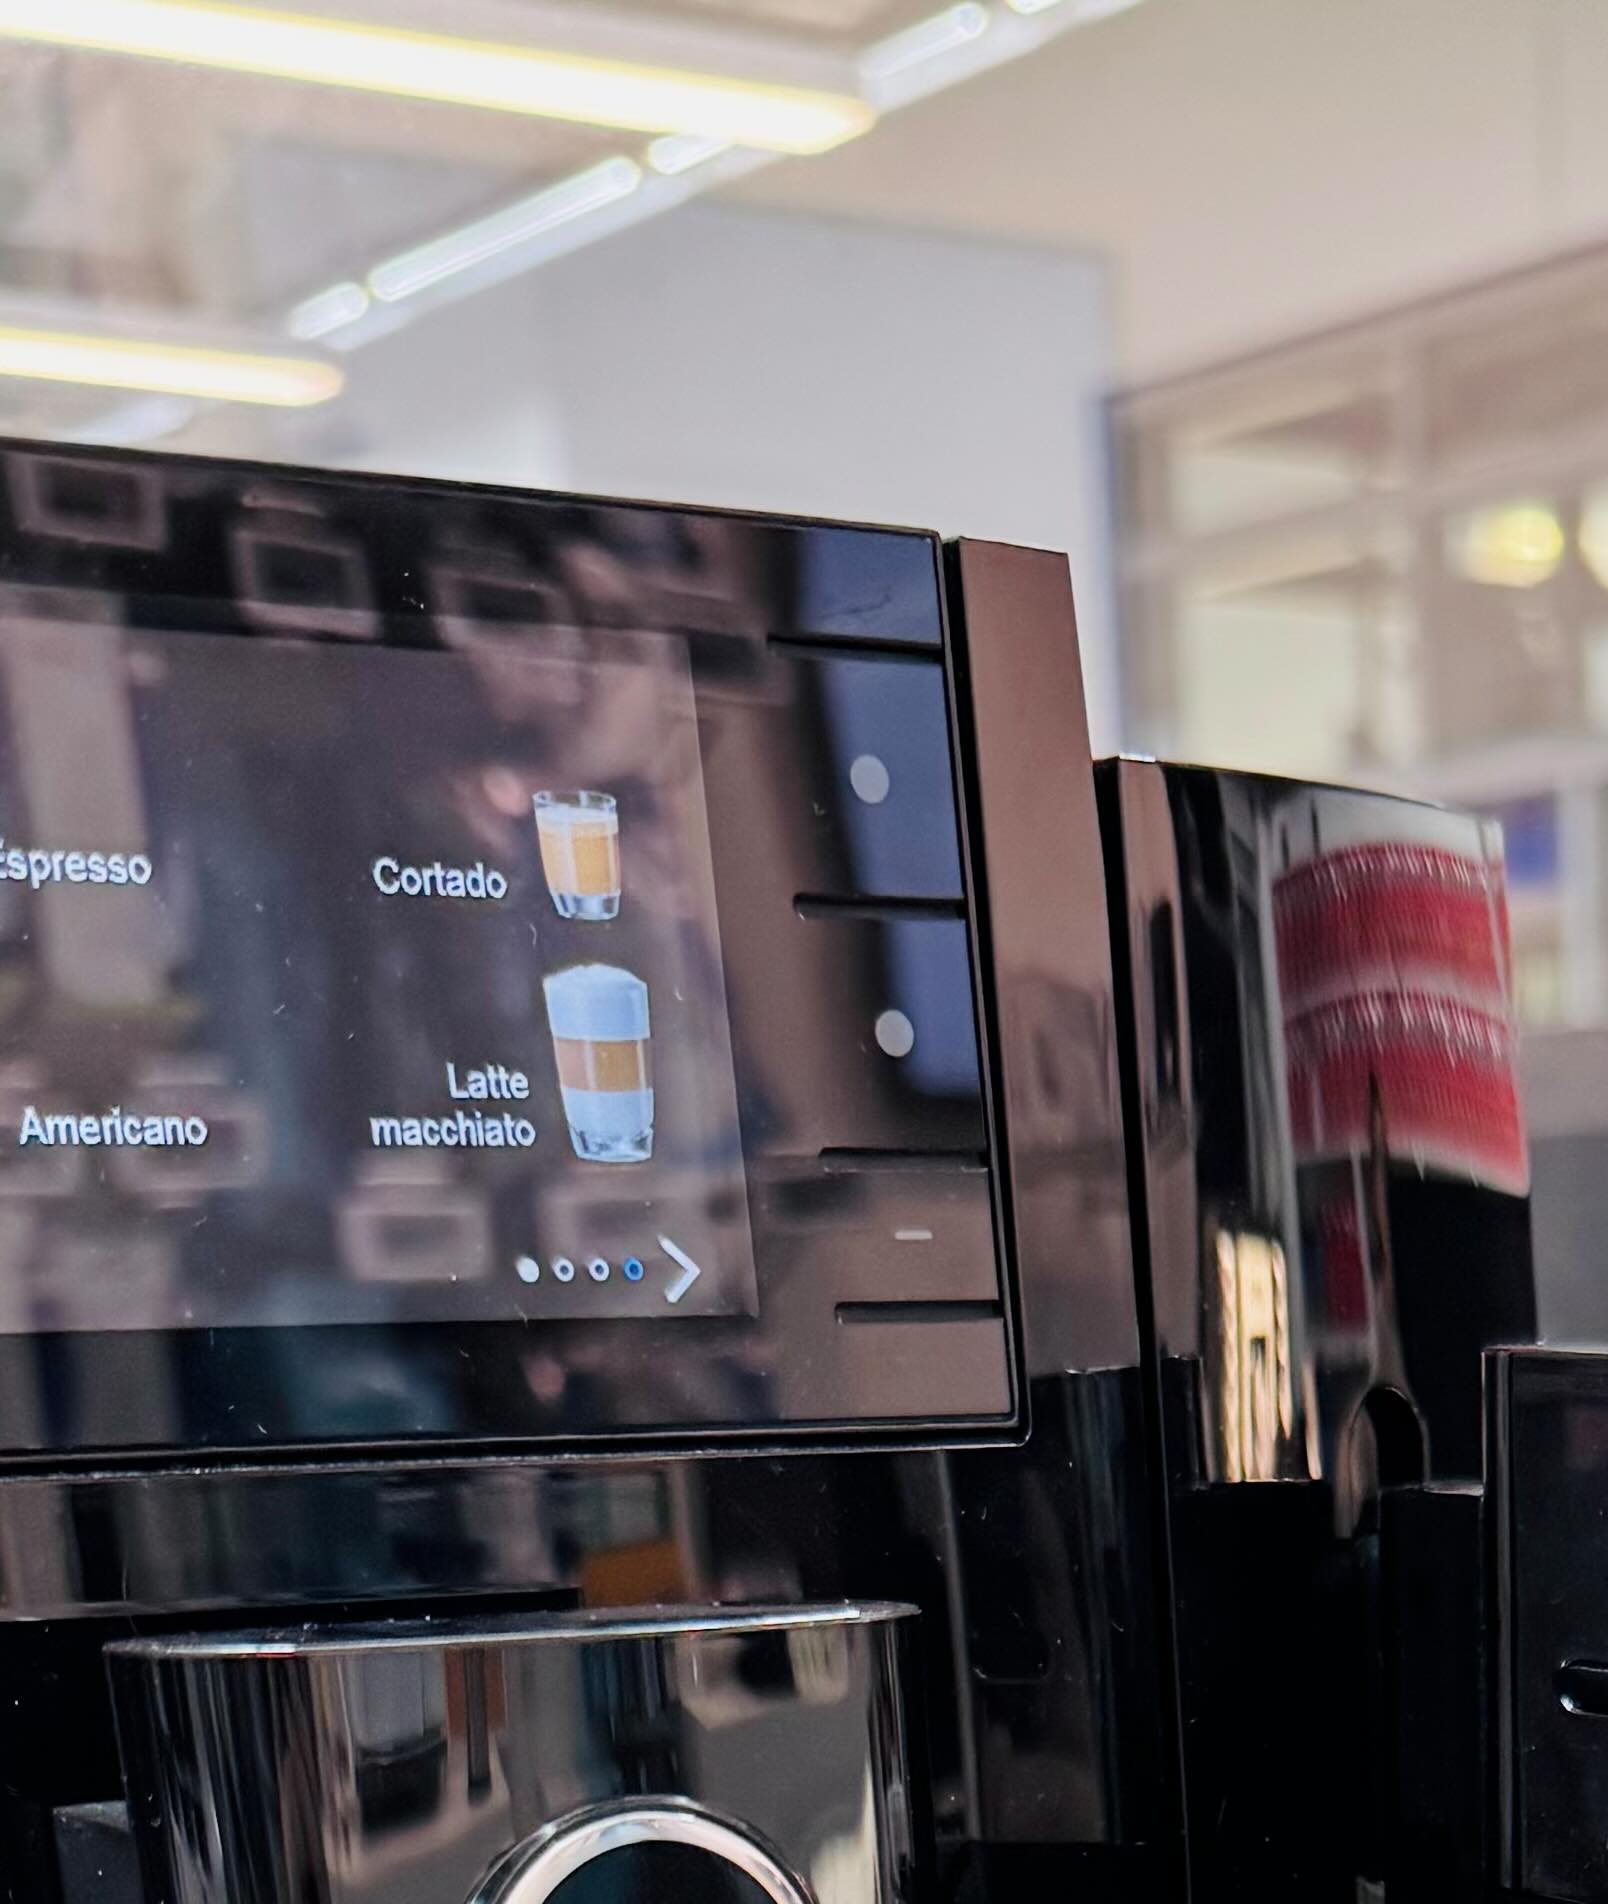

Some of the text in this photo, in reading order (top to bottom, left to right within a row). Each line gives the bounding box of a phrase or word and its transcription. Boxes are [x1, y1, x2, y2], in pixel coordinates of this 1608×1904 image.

[372, 856, 508, 898] Cortado
[446, 1062, 530, 1100] Latte
[19, 1105, 208, 1146] Americano
[369, 1110, 536, 1147] macchiato
